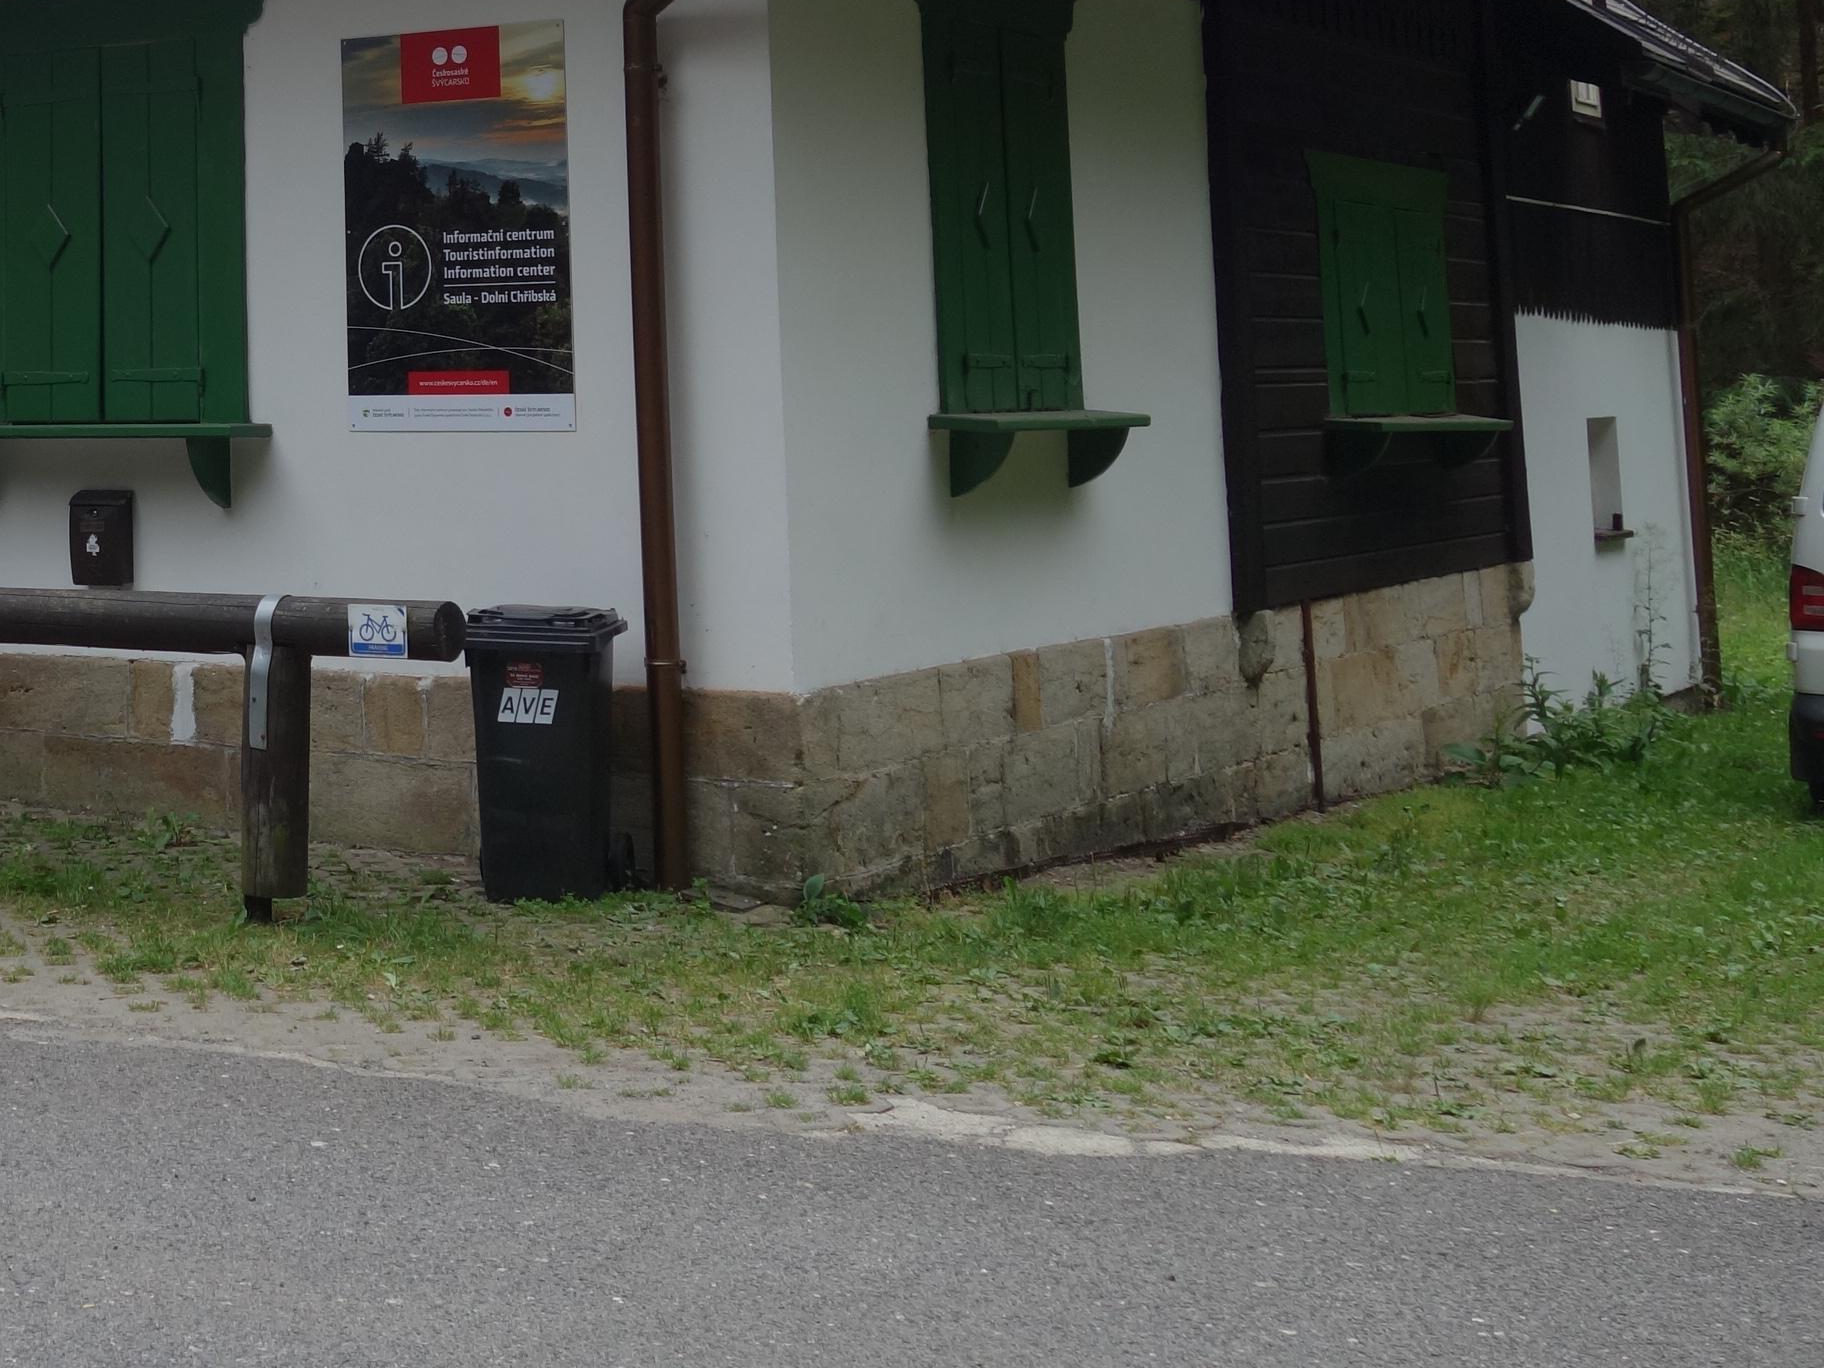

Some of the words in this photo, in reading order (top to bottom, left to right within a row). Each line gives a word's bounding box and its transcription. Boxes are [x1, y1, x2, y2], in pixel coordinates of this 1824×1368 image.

[432, 77, 470, 88] ŠVÝCARSKO
[443, 229, 504, 244] Informační
[506, 228, 555, 241] centrum
[443, 245, 555, 261] Touristinformation
[444, 265, 514, 279] Information
[517, 264, 556, 277] center
[443, 292, 472, 305] Saula
[481, 290, 509, 304] Dolní
[510, 289, 556, 303] Chřibská
[501, 696, 555, 716] AVE
